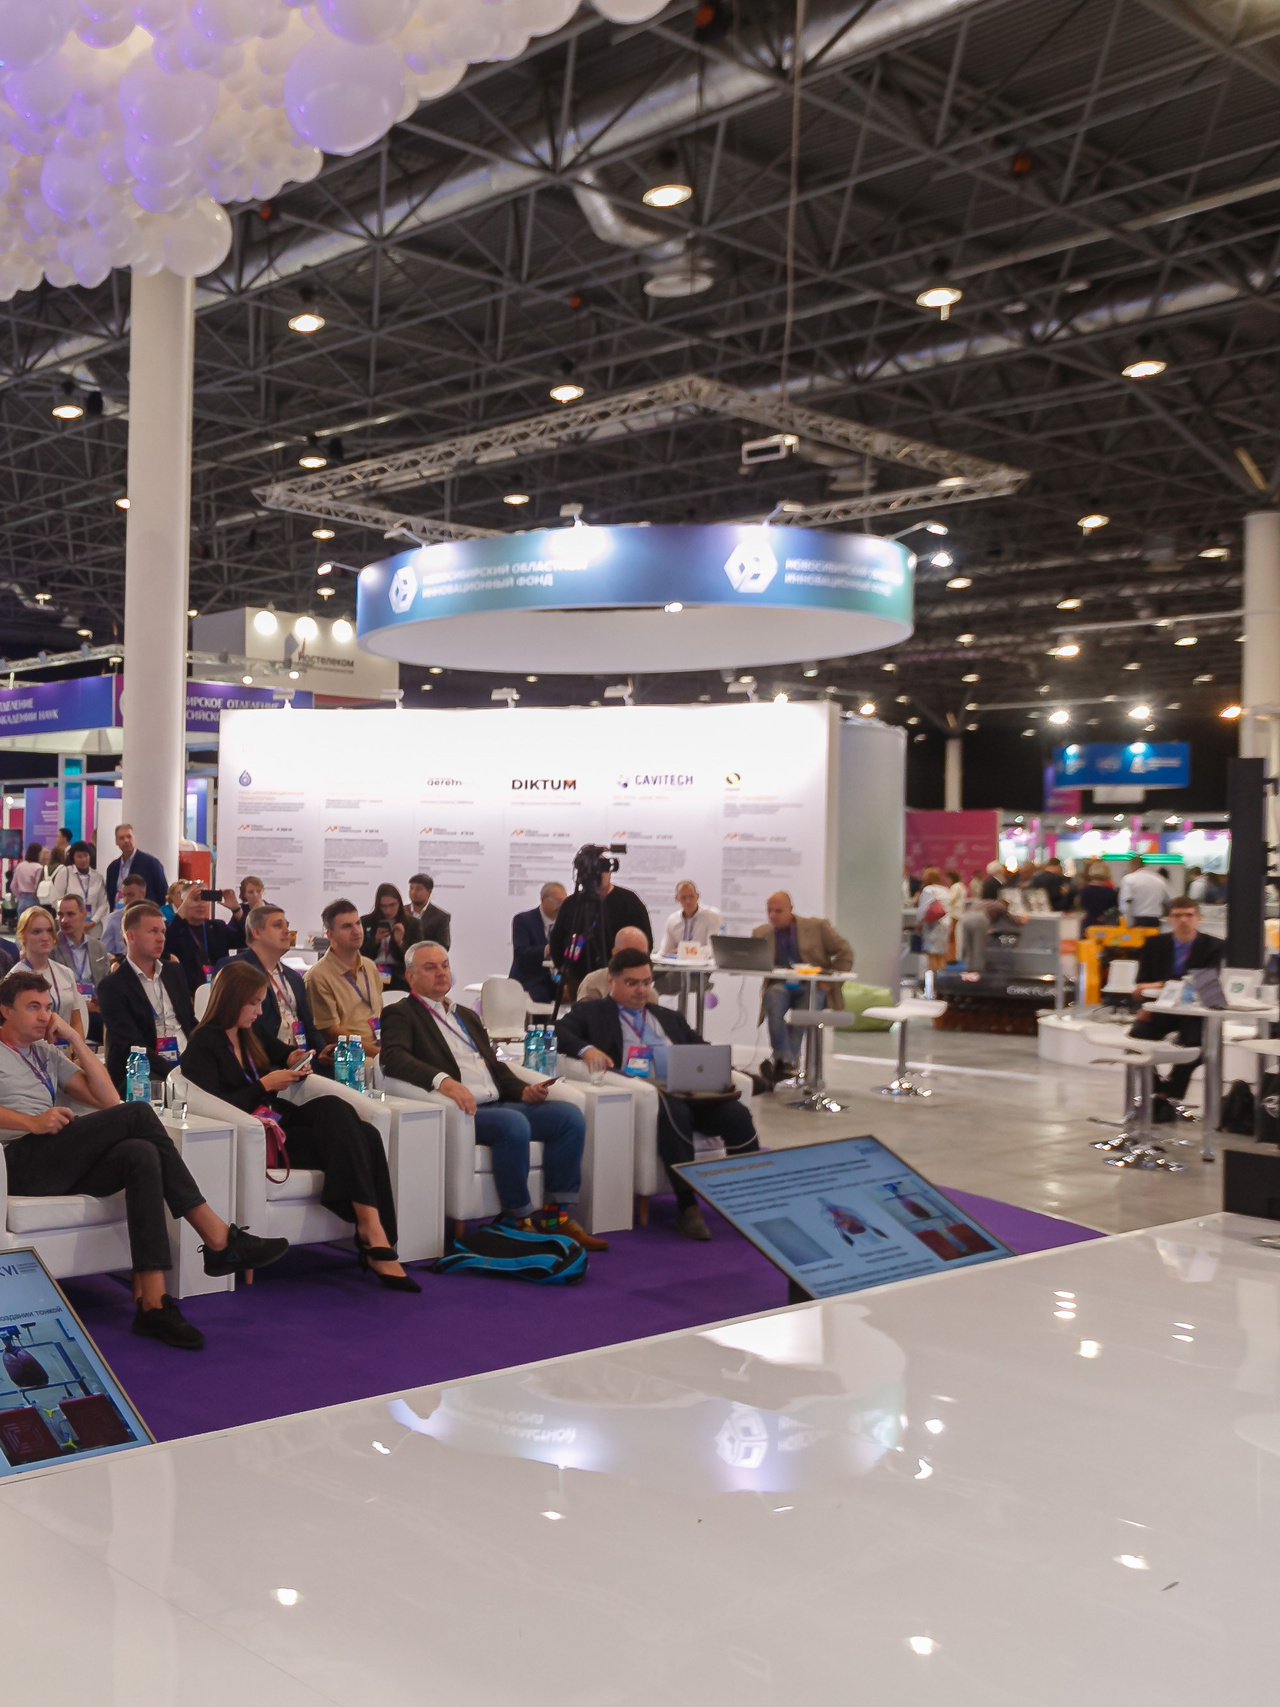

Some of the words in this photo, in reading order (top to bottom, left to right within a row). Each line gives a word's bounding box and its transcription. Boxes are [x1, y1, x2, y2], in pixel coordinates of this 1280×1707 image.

[511, 779, 577, 791] DIKTUM
[635, 774, 694, 786] CAVITECH
[34, 1304, 63, 1317] тонкой
